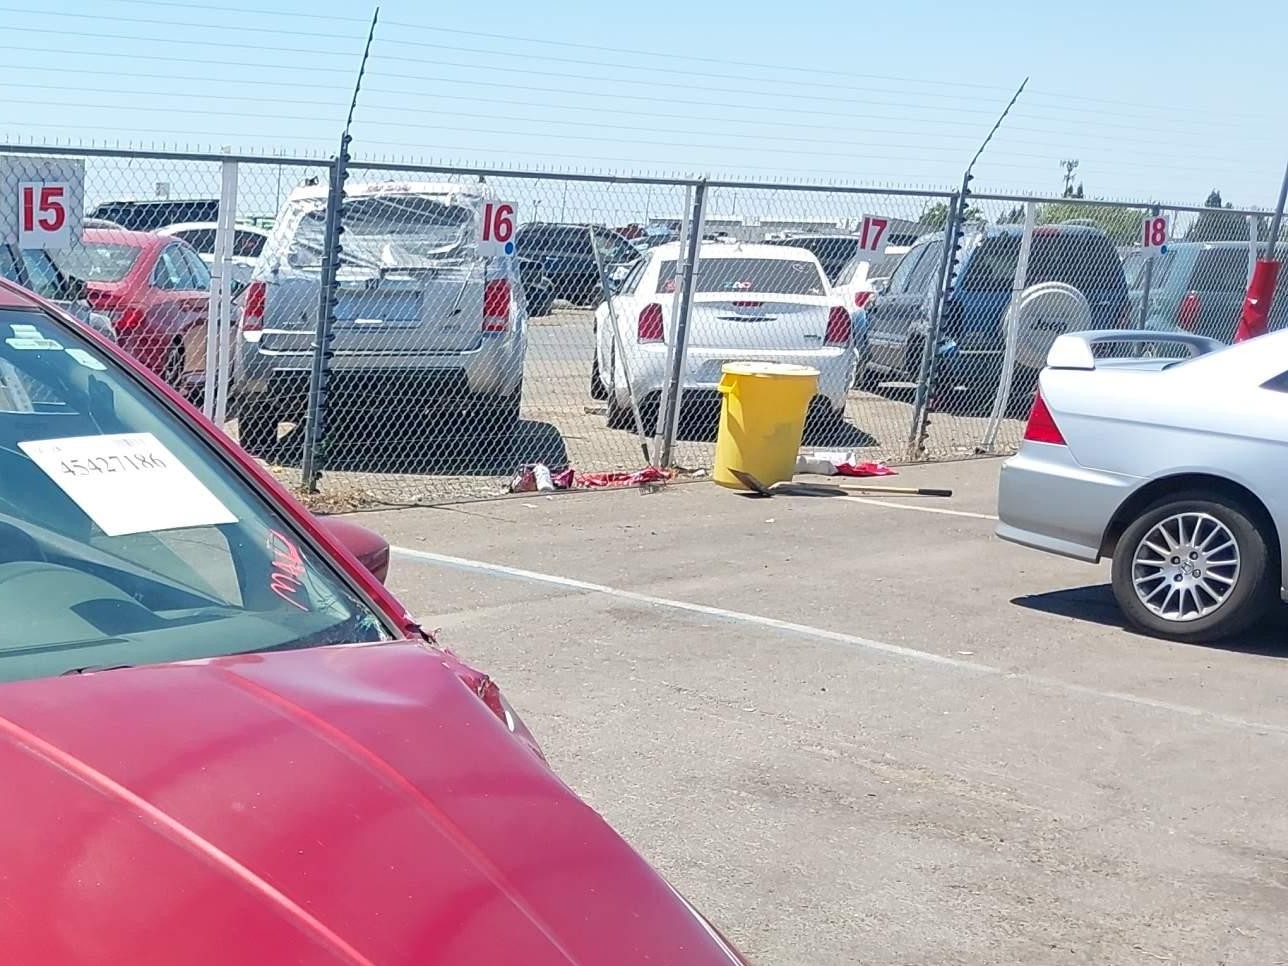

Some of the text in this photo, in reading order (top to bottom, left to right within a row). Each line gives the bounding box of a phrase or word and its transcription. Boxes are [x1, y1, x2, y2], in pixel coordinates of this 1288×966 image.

[23, 187, 66, 232] 15
[483, 203, 514, 242] 16
[860, 217, 888, 251] 17
[1144, 218, 1166, 247] 18
[1030, 319, 1067, 334] Jeep
[60, 453, 168, 477] 45427186
